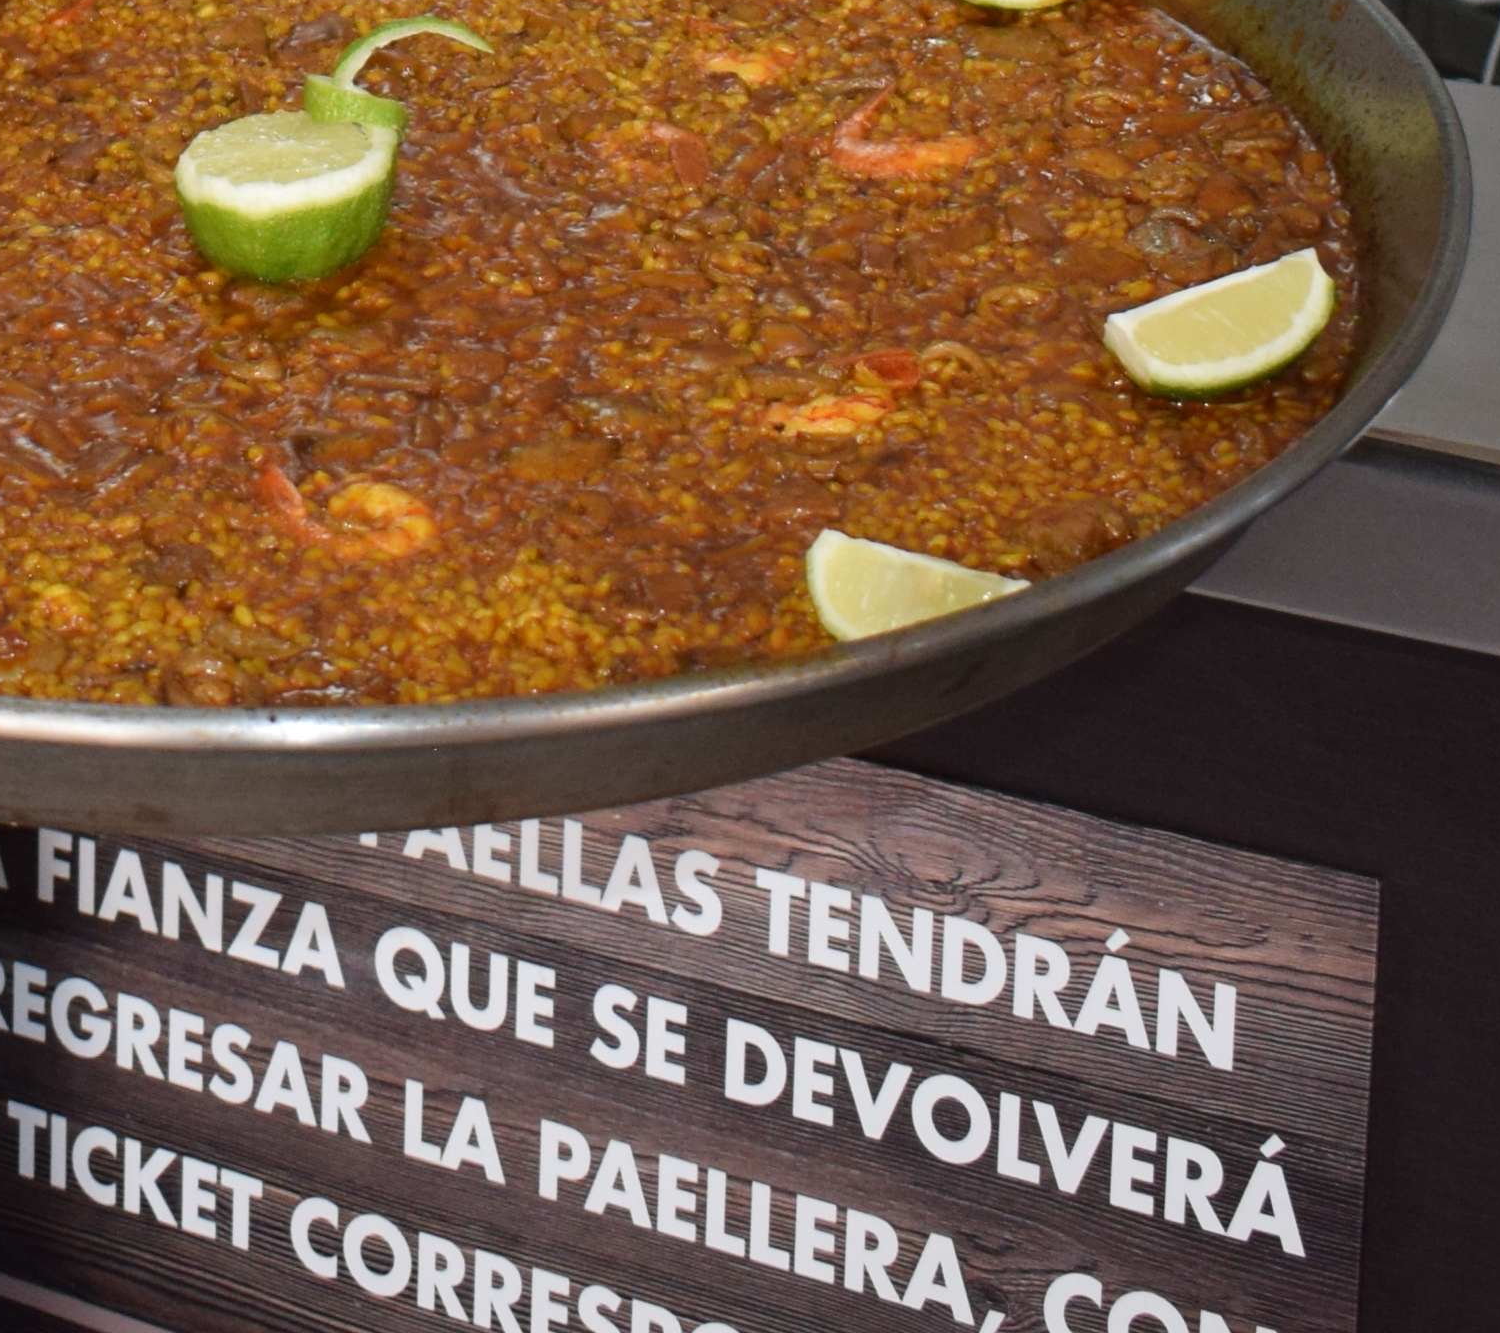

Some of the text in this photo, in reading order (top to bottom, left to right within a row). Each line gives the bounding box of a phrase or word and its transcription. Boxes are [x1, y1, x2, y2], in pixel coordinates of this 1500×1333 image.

[36, 827, 346, 990] FIANZA
[374, 926, 557, 1049] QUE
[589, 983, 688, 1086] SE
[724, 1017, 1306, 1258] DEVOLVERÁ
[359, 818, 1239, 1072] AELLAS TENDRÁN
[6, 1099, 264, 1251] TICKET
[403, 1078, 506, 1186] LA
